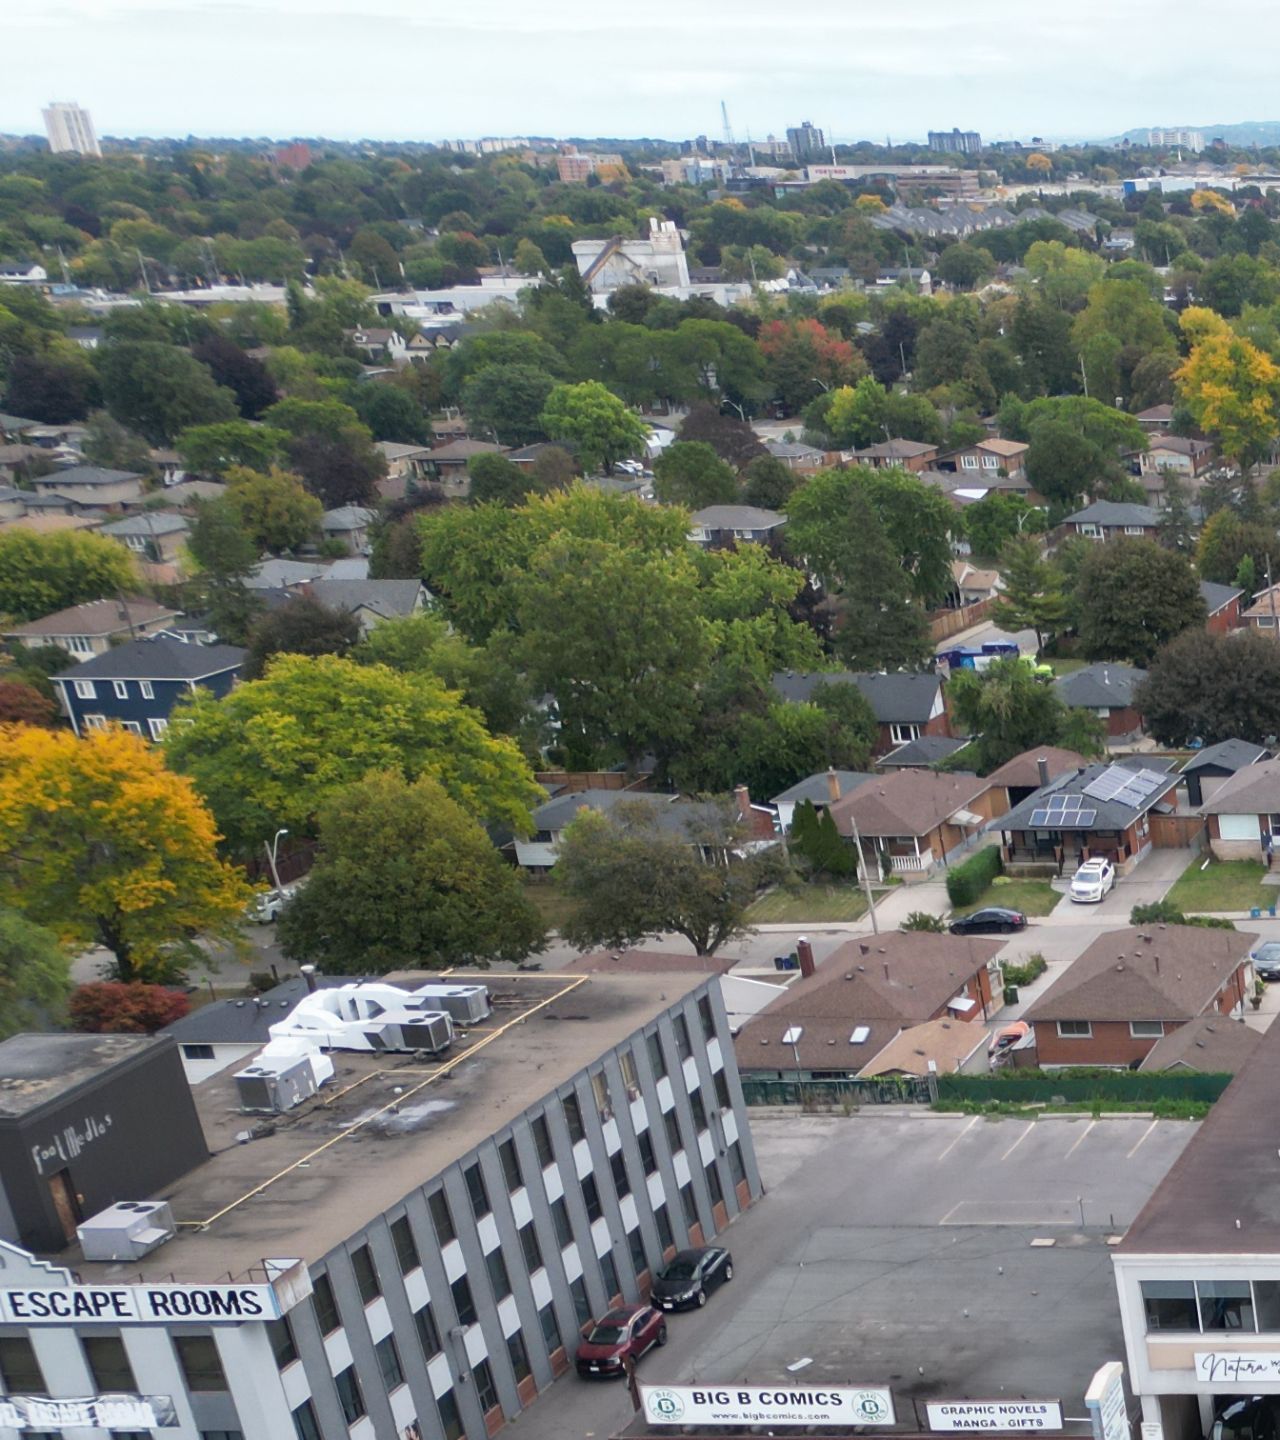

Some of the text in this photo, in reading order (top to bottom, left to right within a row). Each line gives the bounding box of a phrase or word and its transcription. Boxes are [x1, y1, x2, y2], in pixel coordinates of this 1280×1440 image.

[8, 1290, 263, 1317] ESCAPE ROOMS
[692, 1391, 843, 1406] BIG B COMICS
[941, 1404, 1047, 1415] GRAPHIC NOVELS
[712, 1411, 831, 1421] www.bigbcomics.com
[952, 1418, 1044, 1428] MANGA GIFTS
